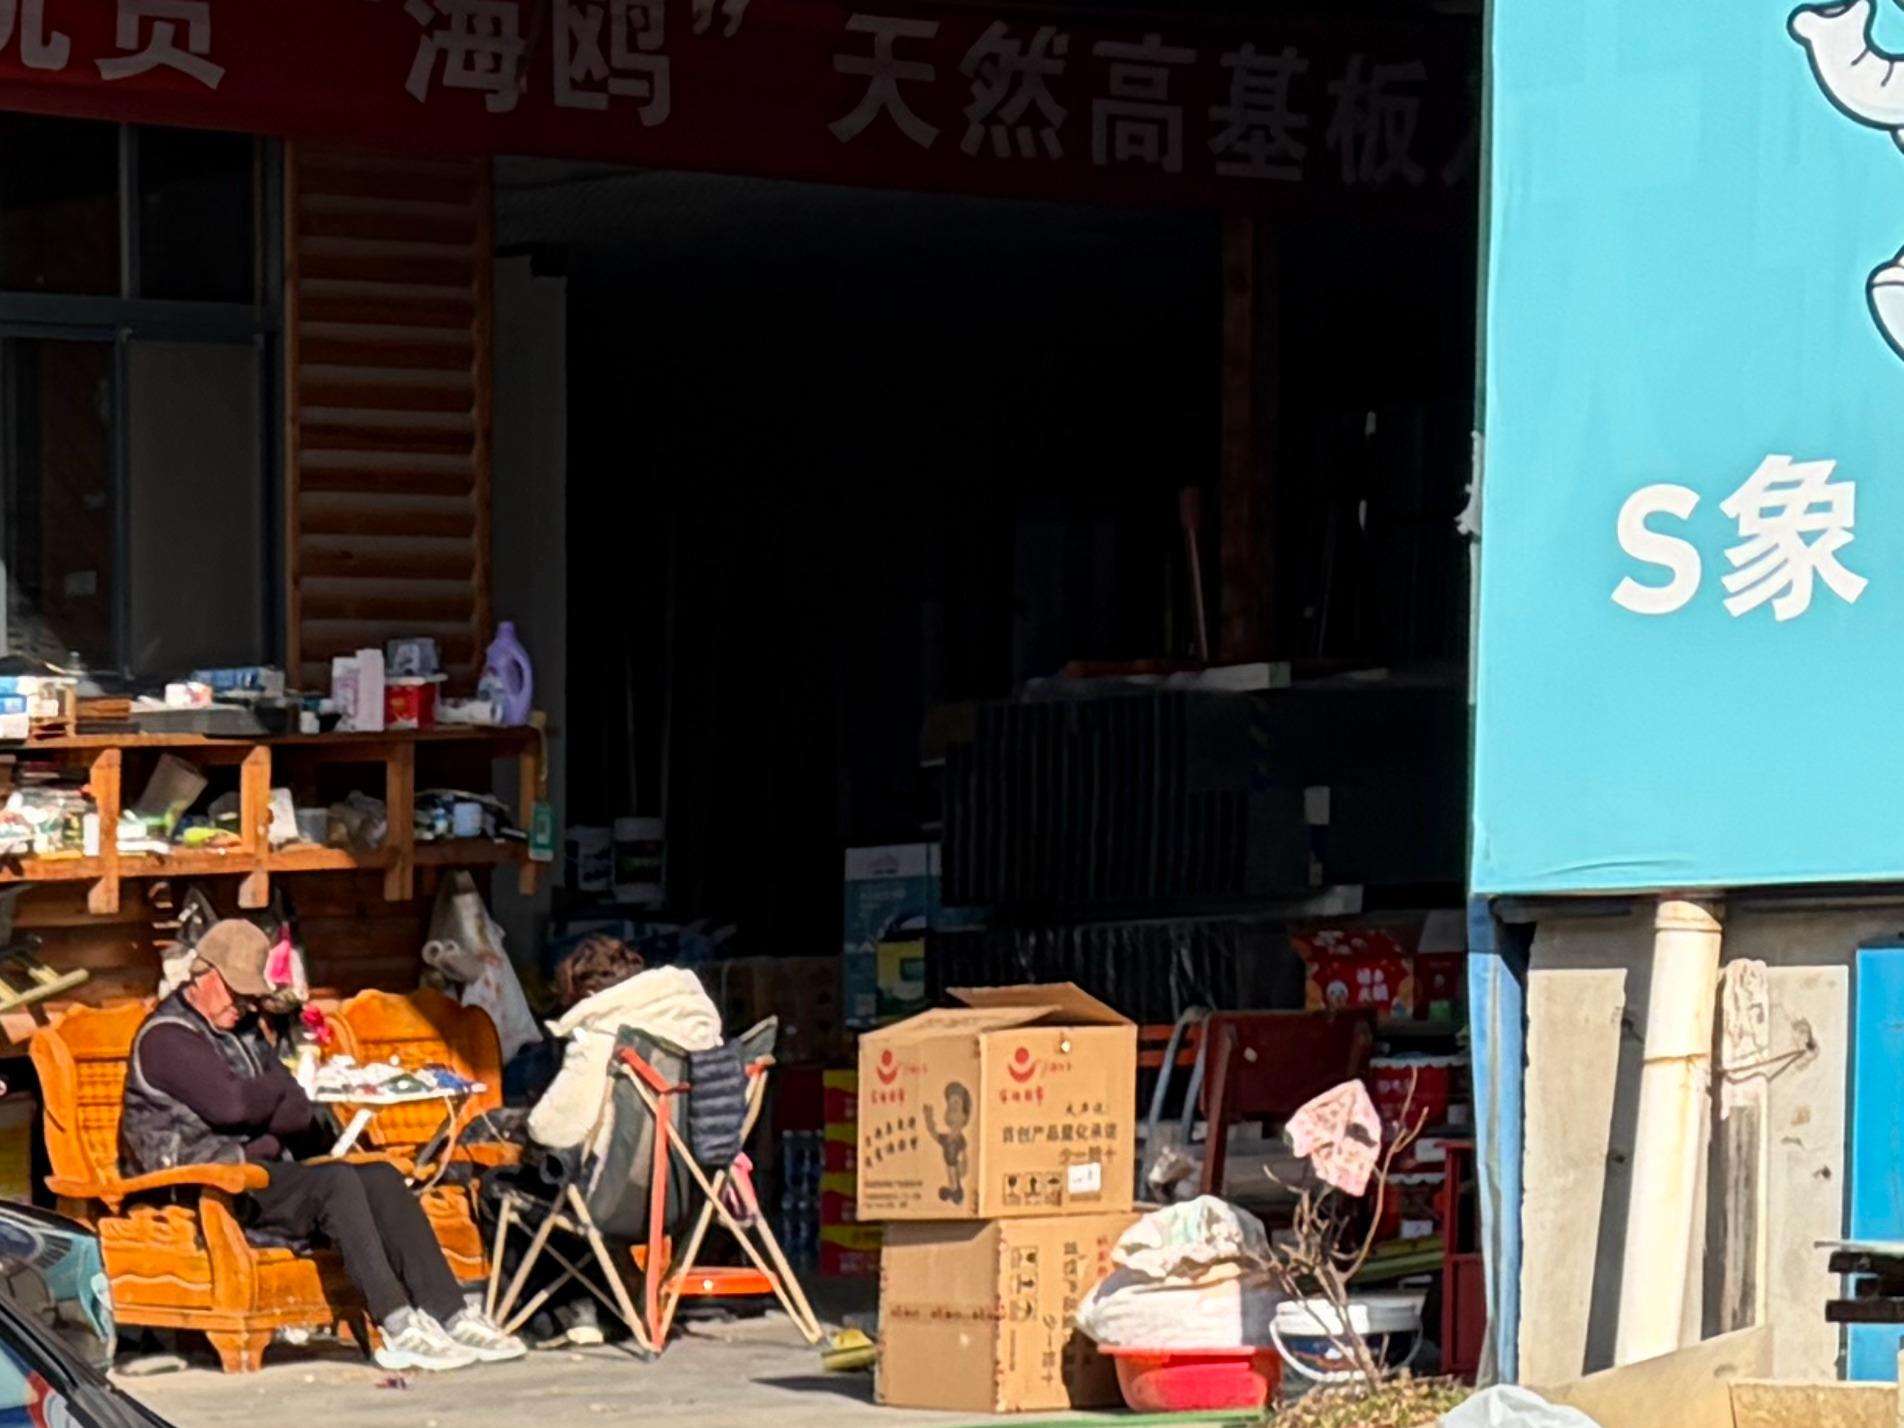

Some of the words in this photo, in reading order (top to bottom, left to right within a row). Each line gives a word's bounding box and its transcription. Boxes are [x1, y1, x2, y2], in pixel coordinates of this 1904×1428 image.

[827, 13, 1474, 188] 天然高基板
